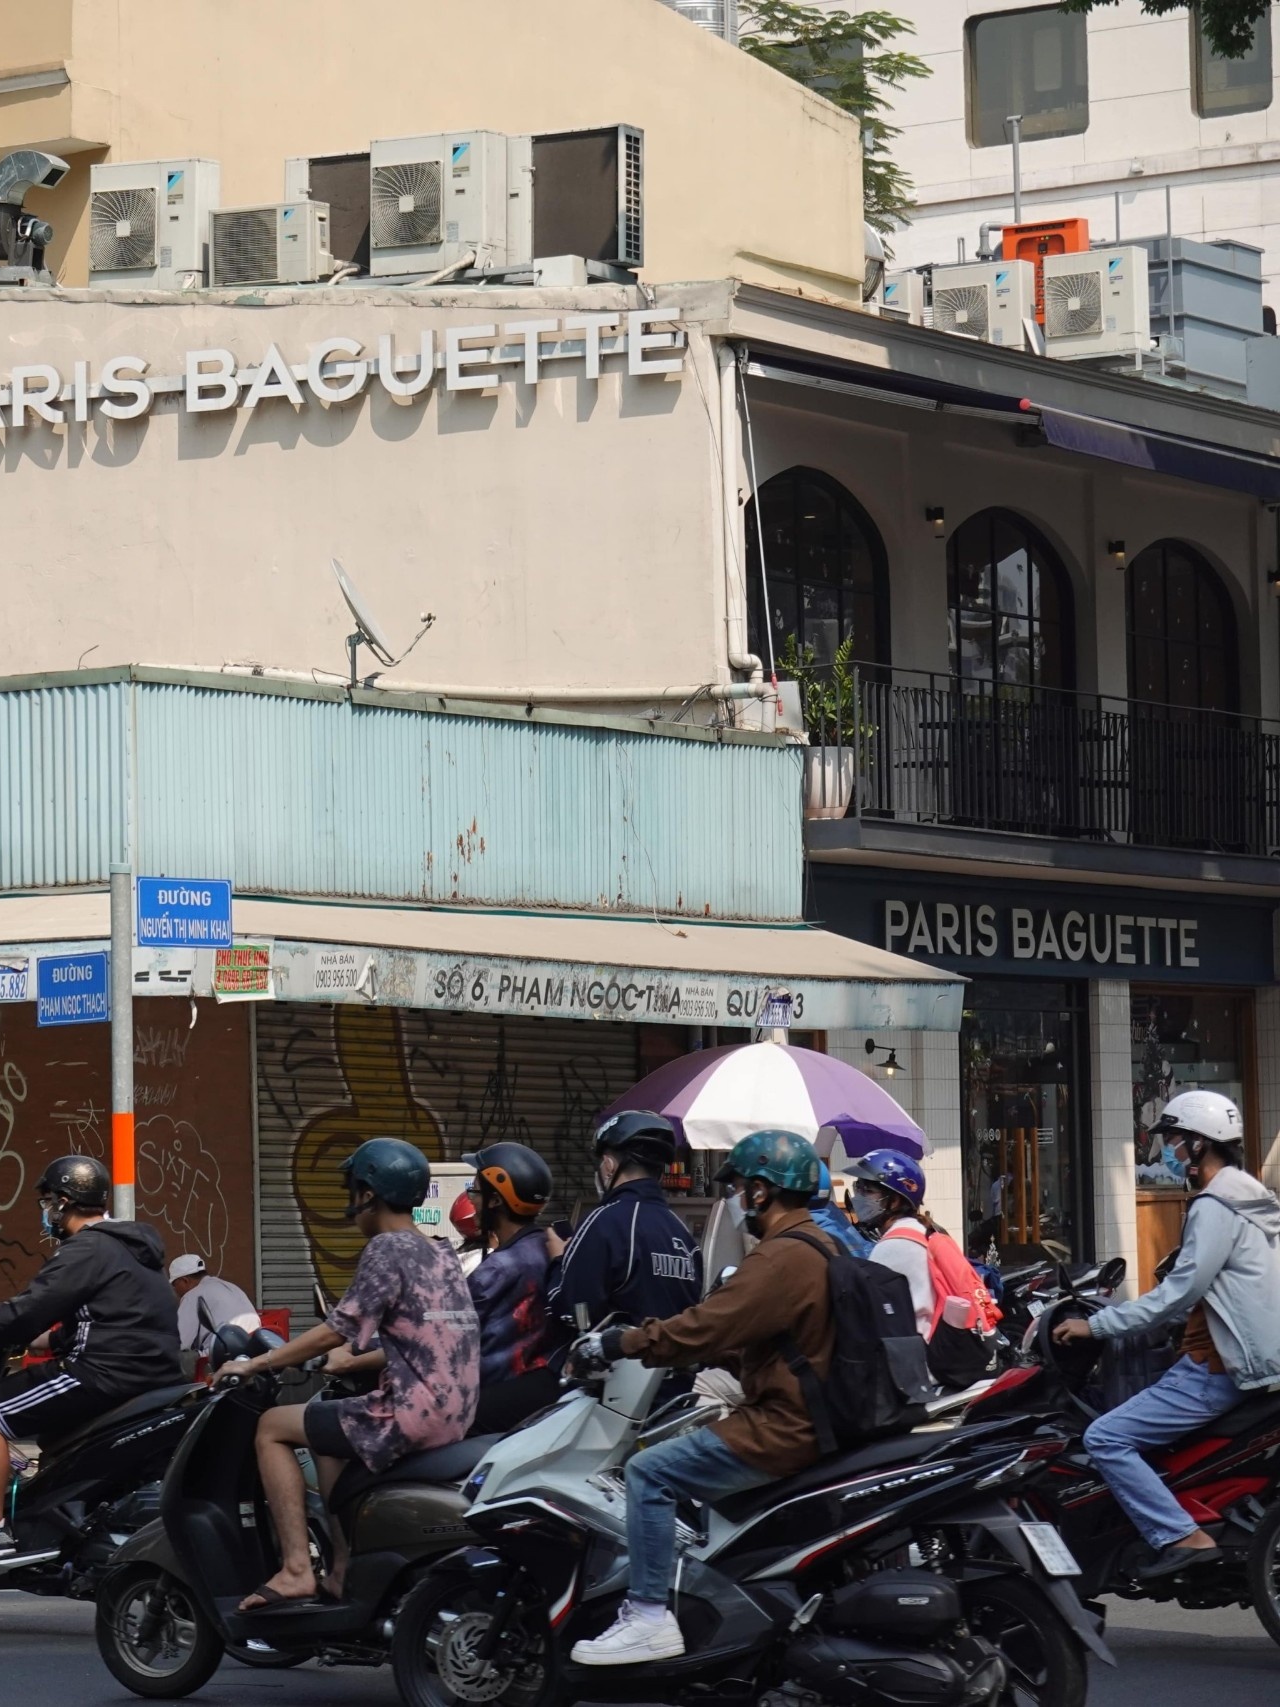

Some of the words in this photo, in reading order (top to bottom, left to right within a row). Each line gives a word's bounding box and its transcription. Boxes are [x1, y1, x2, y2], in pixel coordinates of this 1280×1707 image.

[186, 308, 683, 412] BAGUETTE
[158, 888, 212, 906] ĐƯỜNG
[140, 911, 173, 939] NGUYỄN
[173, 917, 188, 944] THỊ
[188, 919, 209, 939] MINH
[210, 919, 230, 941] KHAI
[884, 900, 998, 957] PARIS
[1012, 908, 1200, 968] BAGUETTE
[216, 949, 231, 966] CHO
[52, 963, 93, 983] ĐƯỜNG
[316, 970, 331, 988] 0903
[333, 970, 344, 987] 956
[345, 969, 358, 986] 500
[434, 960, 468, 999] SỐ
[471, 973, 489, 1006] 6,
[498, 974, 564, 1010] PHẠM
[793, 992, 804, 1019] 3
[40, 997, 61, 1021] PHẠM
[61, 995, 82, 1019] NGỌC
[83, 992, 105, 1017] THẠCH
[651, 1252, 696, 1281] PUMA
